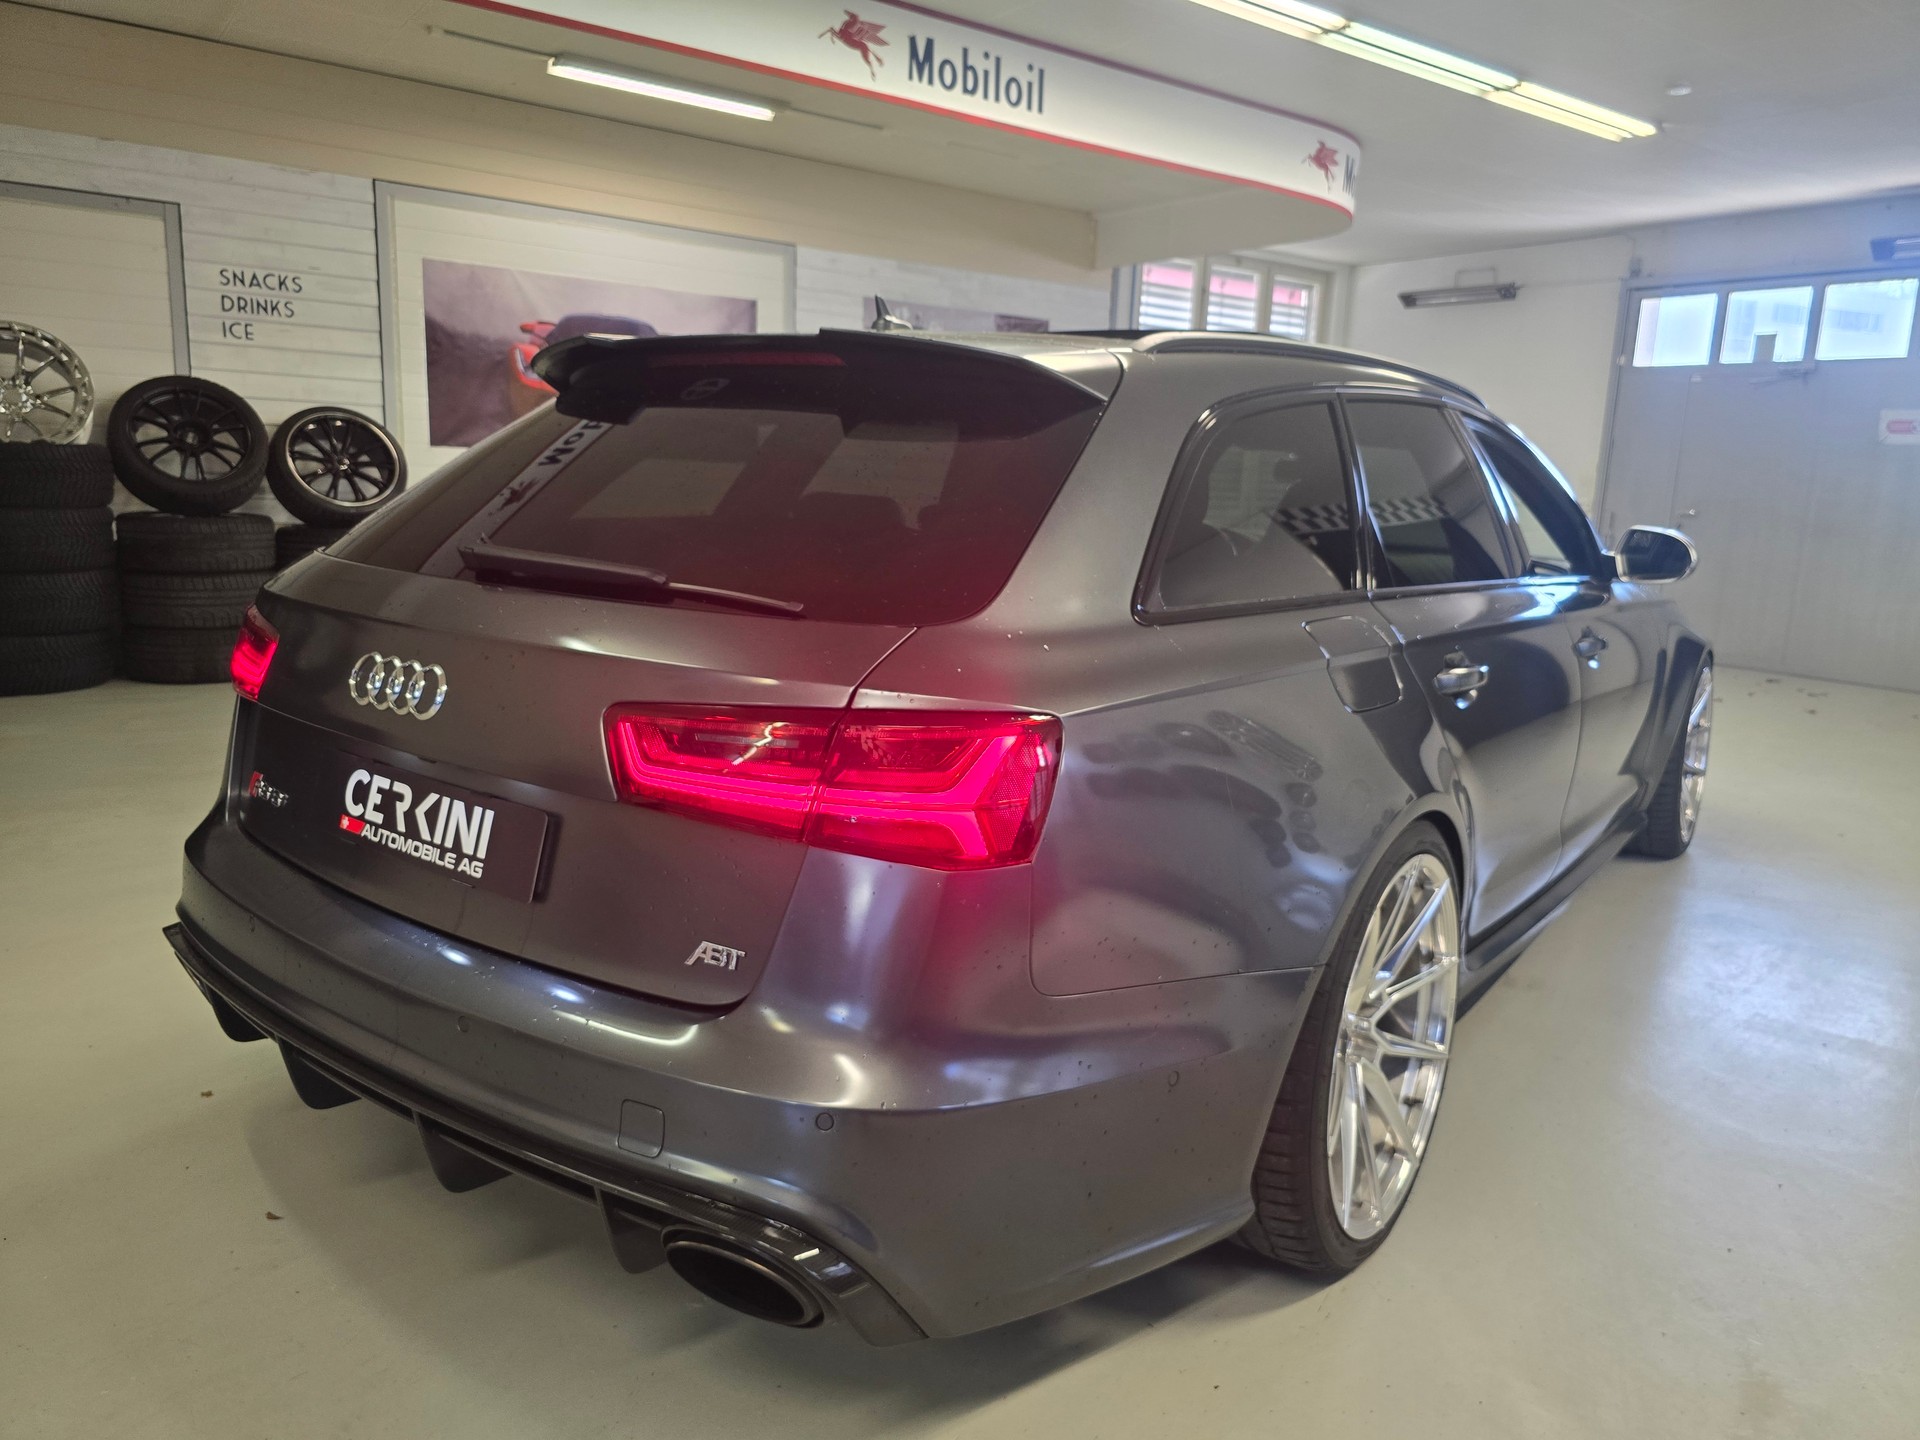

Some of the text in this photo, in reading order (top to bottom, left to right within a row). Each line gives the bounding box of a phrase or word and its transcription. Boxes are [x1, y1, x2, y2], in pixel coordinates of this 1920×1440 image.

[908, 35, 1045, 114] Mobiloil
[219, 268, 303, 293] SNACKS
[221, 294, 295, 318] DRINKS
[222, 321, 254, 341] ICE
[345, 768, 495, 860] CERKINI
[360, 823, 484, 879] AUTOMOBILE AG
[684, 940, 746, 971] ABT
